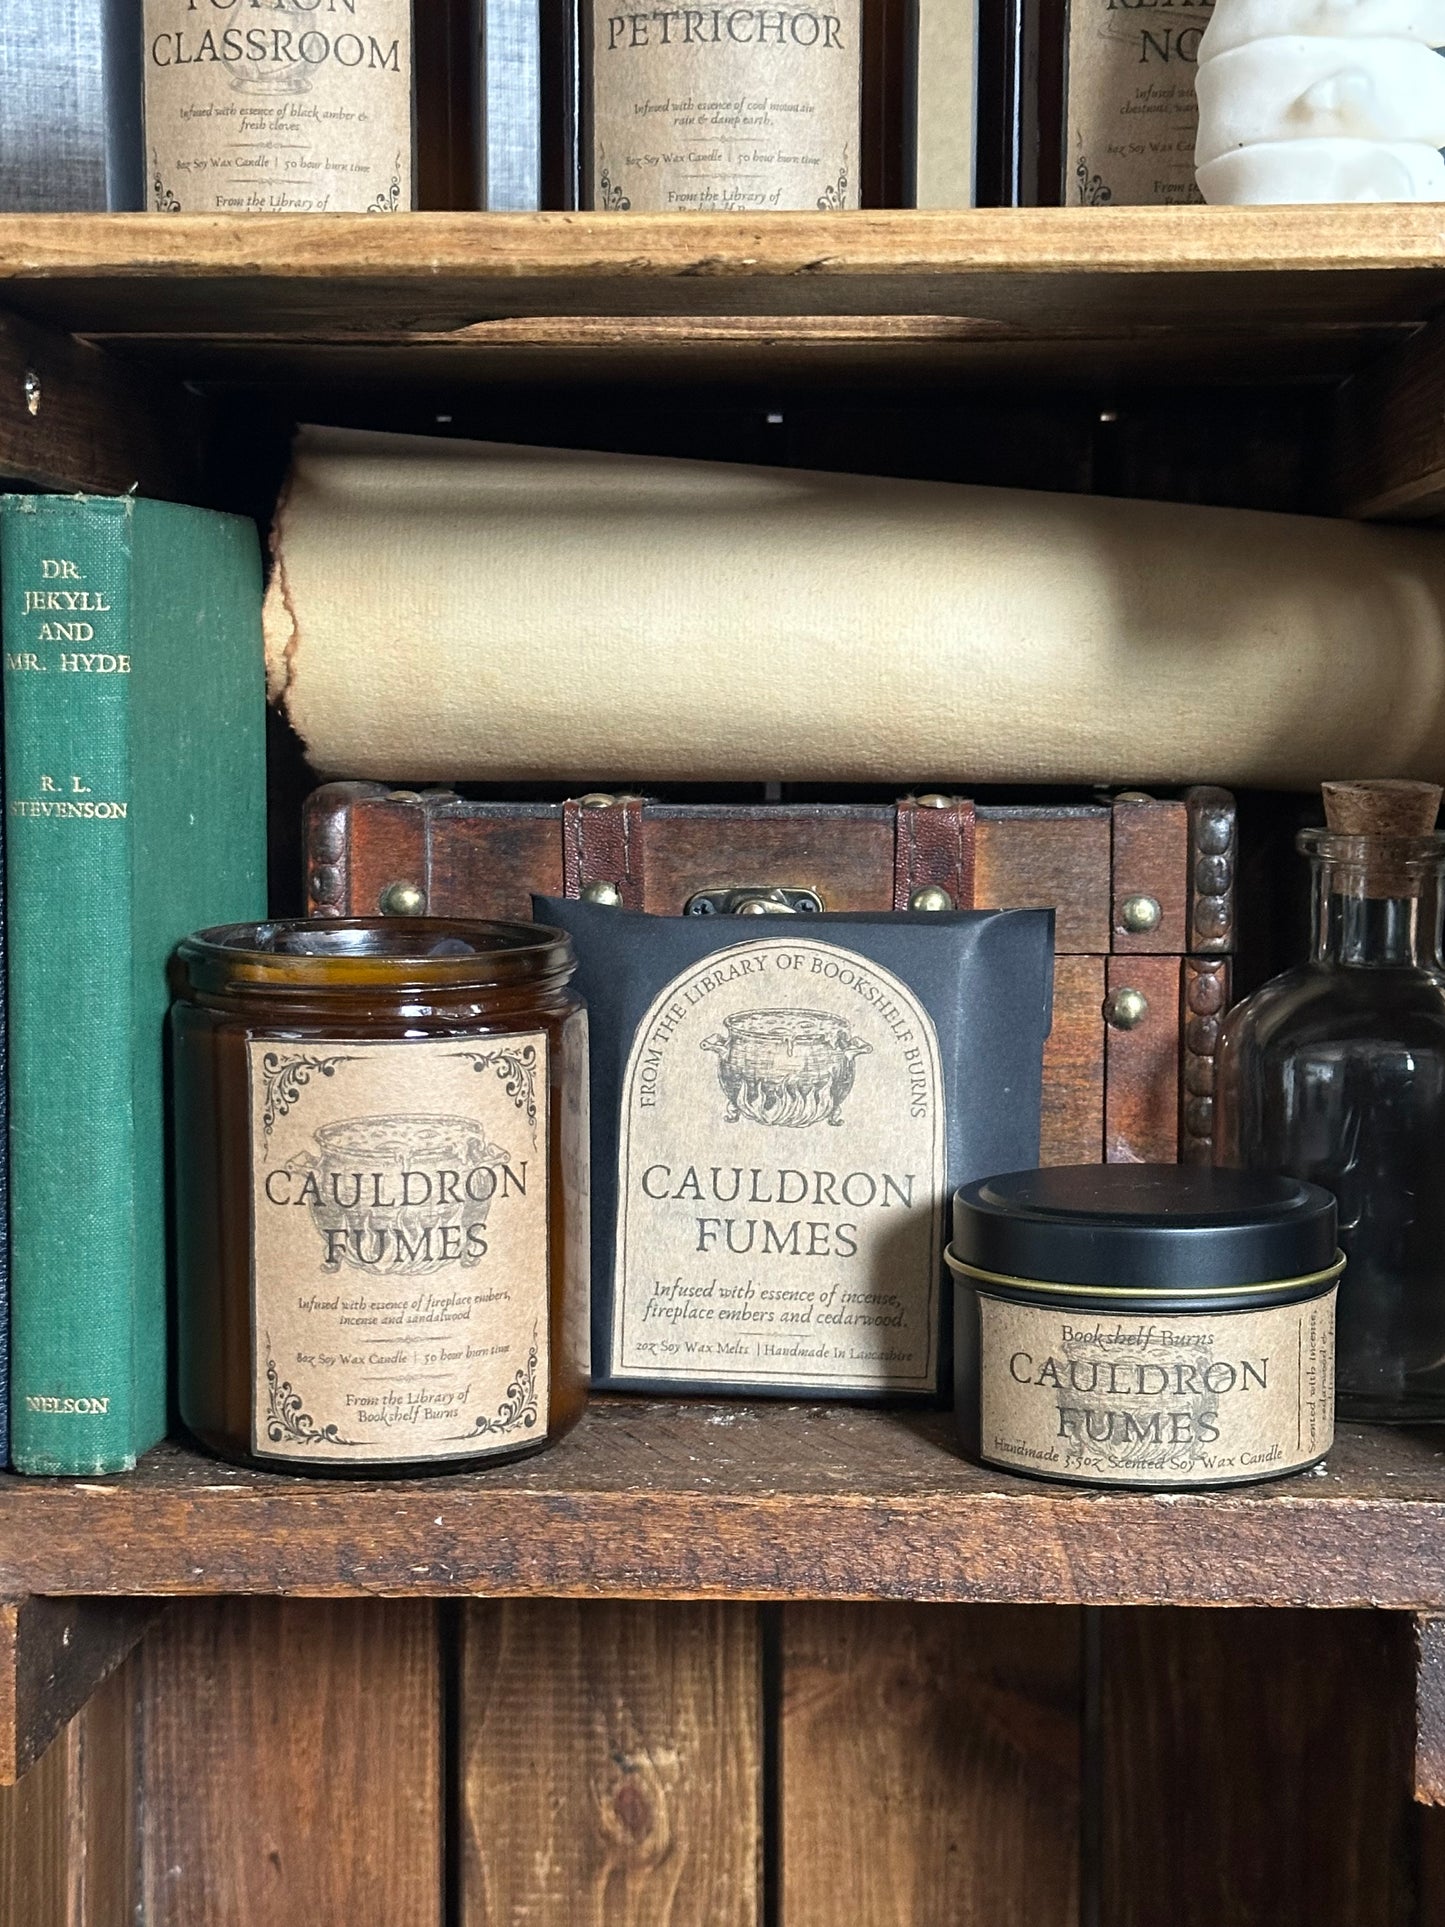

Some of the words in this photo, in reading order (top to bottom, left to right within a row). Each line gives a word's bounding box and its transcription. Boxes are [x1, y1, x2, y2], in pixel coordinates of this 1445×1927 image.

[608, 9, 845, 50] PETRICHOR
[152, 28, 401, 72] CLASSROOM
[1136, 84, 1176, 101] Infused
[180, 104, 211, 120] Infused
[214, 103, 237, 116] with
[239, 107, 275, 116] essence
[277, 103, 289, 119] of
[290, 104, 322, 122] black
[322, 107, 355, 121] amber
[634, 99, 670, 117] Infused
[671, 98, 693, 111] with
[697, 102, 732, 112] essence
[733, 97, 746, 113] of
[747, 98, 767, 111] cool
[769, 103, 815, 113] mountain
[239, 117, 265, 133] fresh
[269, 118, 300, 131] cloves
[674, 116, 696, 126] rain
[710, 113, 741, 128] damp
[193, 158, 207, 171] Soy
[210, 157, 232, 168] Wax
[235, 155, 269, 168] Candle
[284, 160, 298, 171] 50
[300, 157, 322, 169] hour
[325, 158, 348, 171] burn
[350, 163, 371, 173] time
[644, 155, 660, 166] Soy
[662, 153, 685, 163] Wax
[688, 149, 722, 162] Candle
[738, 153, 750, 164] 50
[752, 150, 774, 163] hour
[776, 151, 799, 164] burn
[801, 155, 820, 166] time
[668, 191, 697, 203] From
[700, 187, 719, 202] the
[722, 187, 766, 204] Library
[769, 188, 783, 205] of
[1154, 181, 1185, 192] From
[216, 195, 243, 207] From
[247, 192, 266, 207] the
[269, 193, 313, 210] Library
[316, 194, 330, 211] of
[42, 559, 87, 579] DR.
[22, 591, 111, 615] JEKYLL
[38, 622, 94, 641] AND
[7, 652, 47, 671] MR.
[61, 653, 131, 672] HYDE
[41, 776, 62, 792] R.
[72, 776, 92, 793] L.
[9, 801, 127, 819] STEVENSON
[640, 1048, 663, 1108] FROM
[652, 1003, 687, 1043] THE
[684, 955, 768, 1006] LIBRARY
[776, 954, 805, 970] OF
[810, 957, 914, 1043] BOOKSHELF
[904, 1047, 928, 1118] BURNS
[265, 1161, 528, 1208] CAULDRON
[641, 1164, 915, 1209] CAULDRON
[323, 1223, 488, 1264] FUMES
[695, 1217, 858, 1258] FUMES
[298, 1295, 340, 1313] Infused
[341, 1296, 367, 1310] with
[370, 1301, 408, 1310] essence
[411, 1294, 425, 1311] of
[425, 1292, 472, 1310] fireplace
[474, 1288, 511, 1304] embers,
[654, 1277, 717, 1301] Infused
[718, 1280, 755, 1299] with
[760, 1288, 815, 1302] essence
[819, 1283, 840, 1308] of
[841, 1290, 902, 1308] incense,
[339, 1314, 378, 1325] incense
[381, 1311, 404, 1324] and
[406, 1309, 471, 1324] sandalwood
[642, 1298, 715, 1325] fireplace
[718, 1303, 774, 1322] embers
[780, 1304, 811, 1324] and
[816, 1307, 908, 1328] cedarwood.
[1062, 1323, 1156, 1350] Bookshelf
[1161, 1330, 1215, 1346] Burns
[318, 1353, 335, 1367] Soy
[339, 1353, 365, 1365] Wax
[369, 1351, 407, 1365] Candle
[424, 1353, 437, 1365] 50
[440, 1348, 463, 1361] hour
[466, 1345, 489, 1359] burn
[490, 1344, 510, 1355] time
[660, 1341, 680, 1355] Soy
[684, 1342, 712, 1353] Wax
[717, 1340, 749, 1355] Melts
[764, 1343, 829, 1359] Handmade
[849, 1347, 913, 1362] Lancashire
[1009, 1352, 1269, 1396] CAULDRON
[1306, 1368, 1316, 1398] with
[26, 1396, 111, 1414] NELSON
[346, 1393, 379, 1407] From
[382, 1390, 404, 1405] the
[407, 1388, 455, 1405] Library
[457, 1384, 472, 1404] of
[358, 1404, 420, 1426] Bookshelf
[424, 1407, 459, 1420] Burns
[1056, 1405, 1221, 1444] FUMES
[1306, 1401, 1317, 1453] Scented
[993, 1438, 1059, 1462] Handmade
[1063, 1455, 1105, 1473] 3.5oz
[1108, 1455, 1166, 1469] Scented
[1169, 1457, 1196, 1473] Soy
[1201, 1456, 1236, 1469] Wax
[1240, 1443, 1284, 1466] Candle
